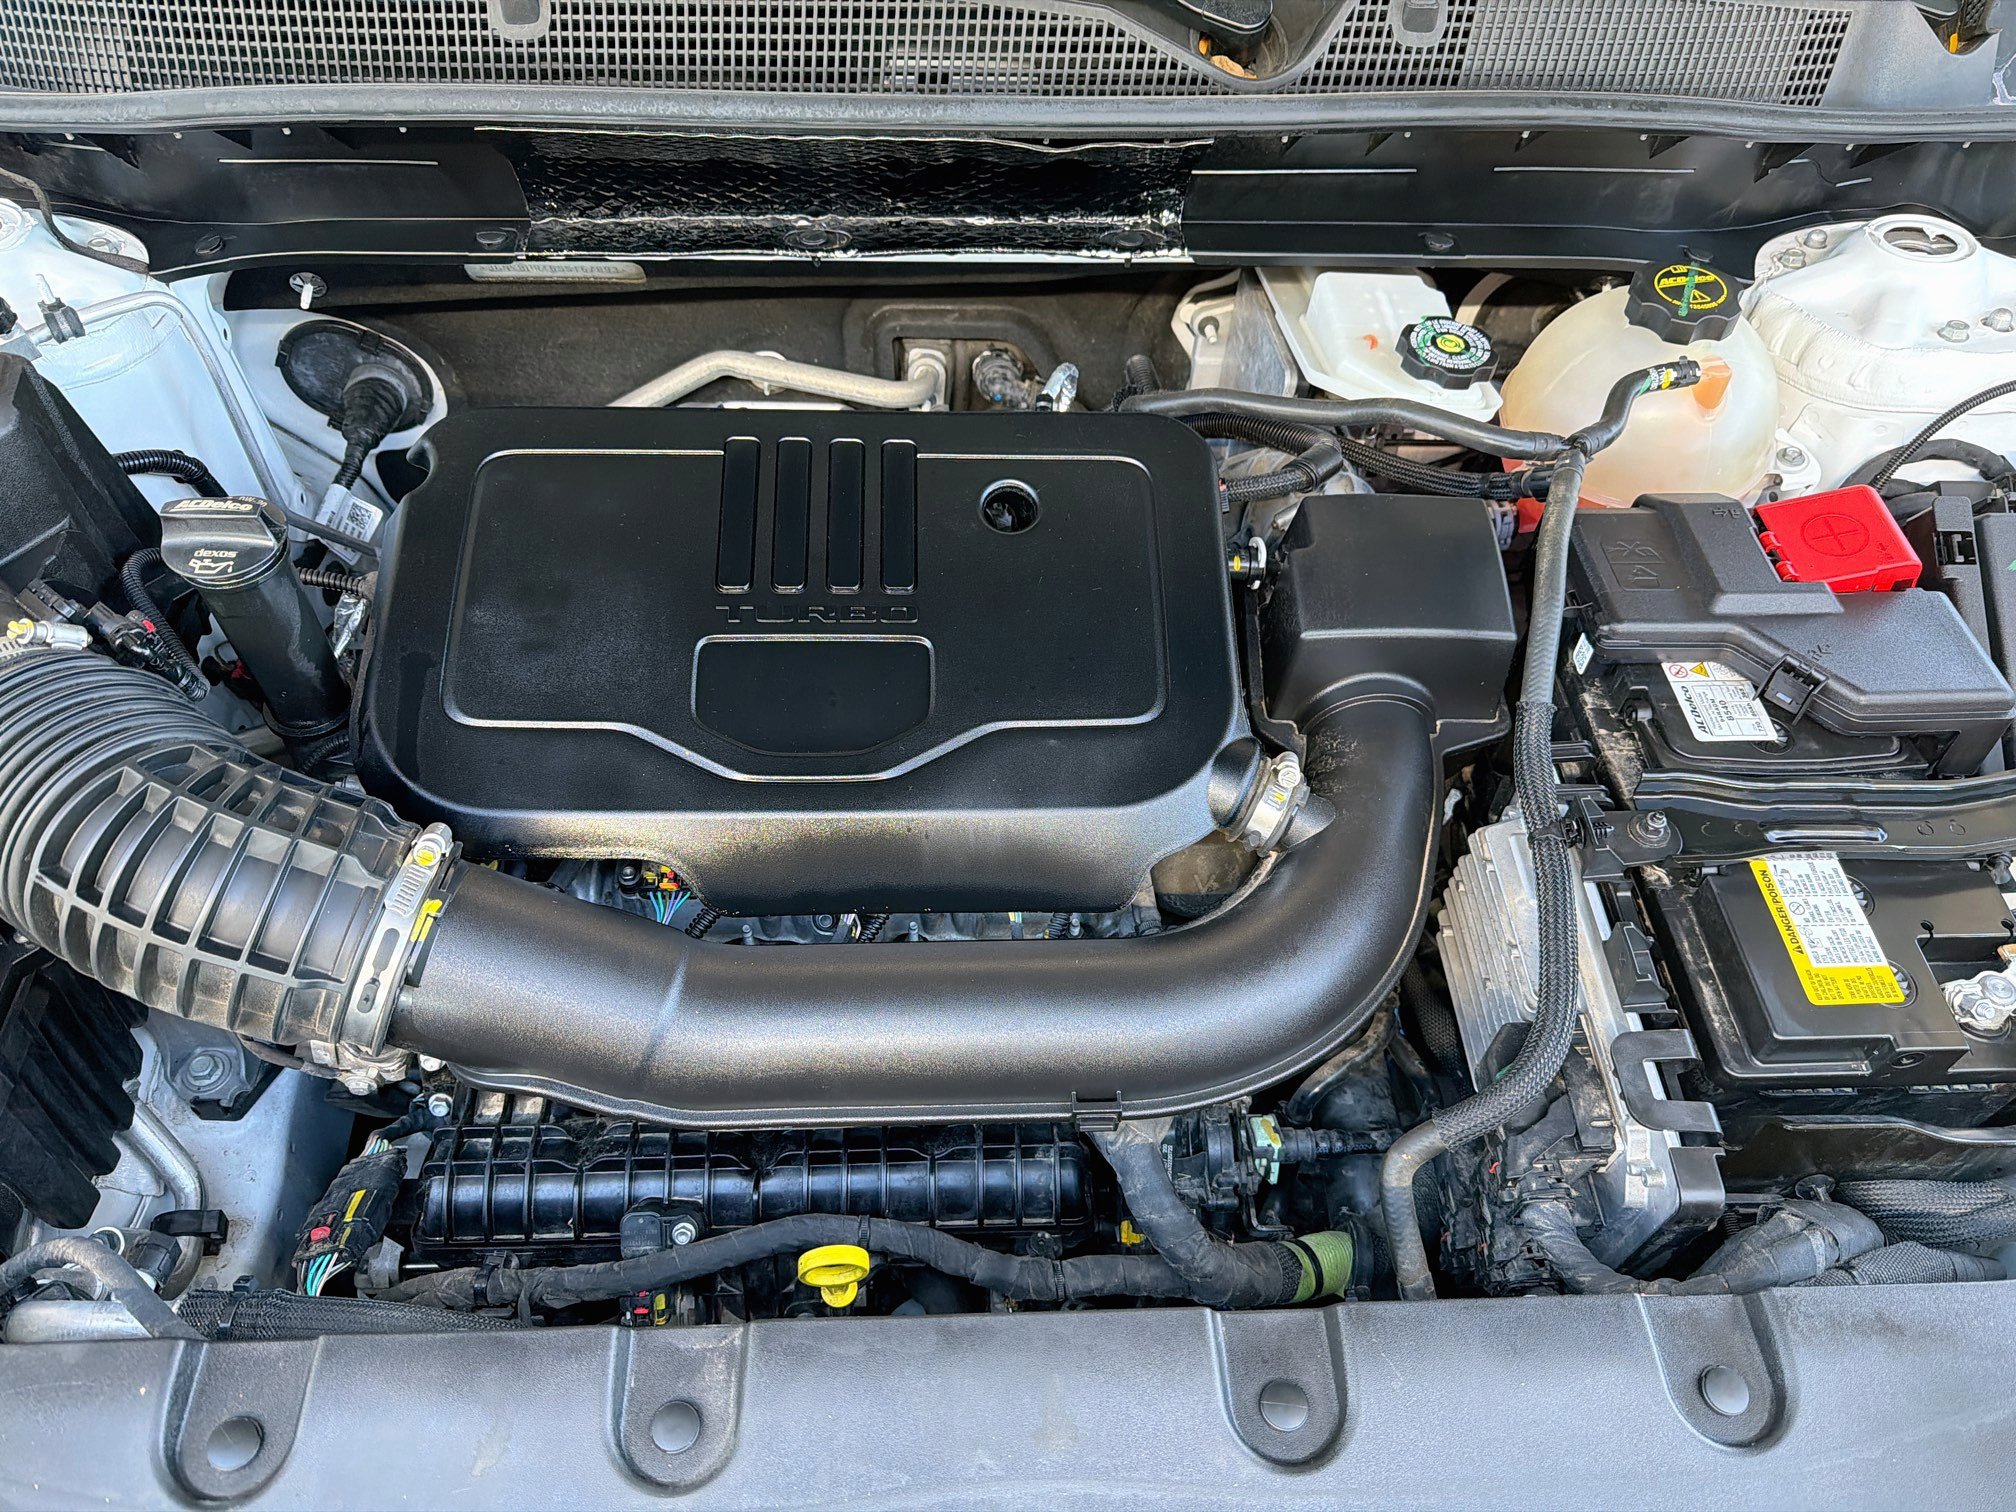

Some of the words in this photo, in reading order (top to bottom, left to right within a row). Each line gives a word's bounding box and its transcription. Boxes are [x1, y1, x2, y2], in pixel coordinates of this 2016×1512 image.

[1659, 275, 1715, 288] ACDlco
[174, 500, 253, 511] ACDelco
[194, 548, 238, 558] dexos
[715, 606, 919, 623] TURBO
[1681, 685, 1709, 735] ACDelco
[1759, 868, 1800, 944] DANGER/POISON
